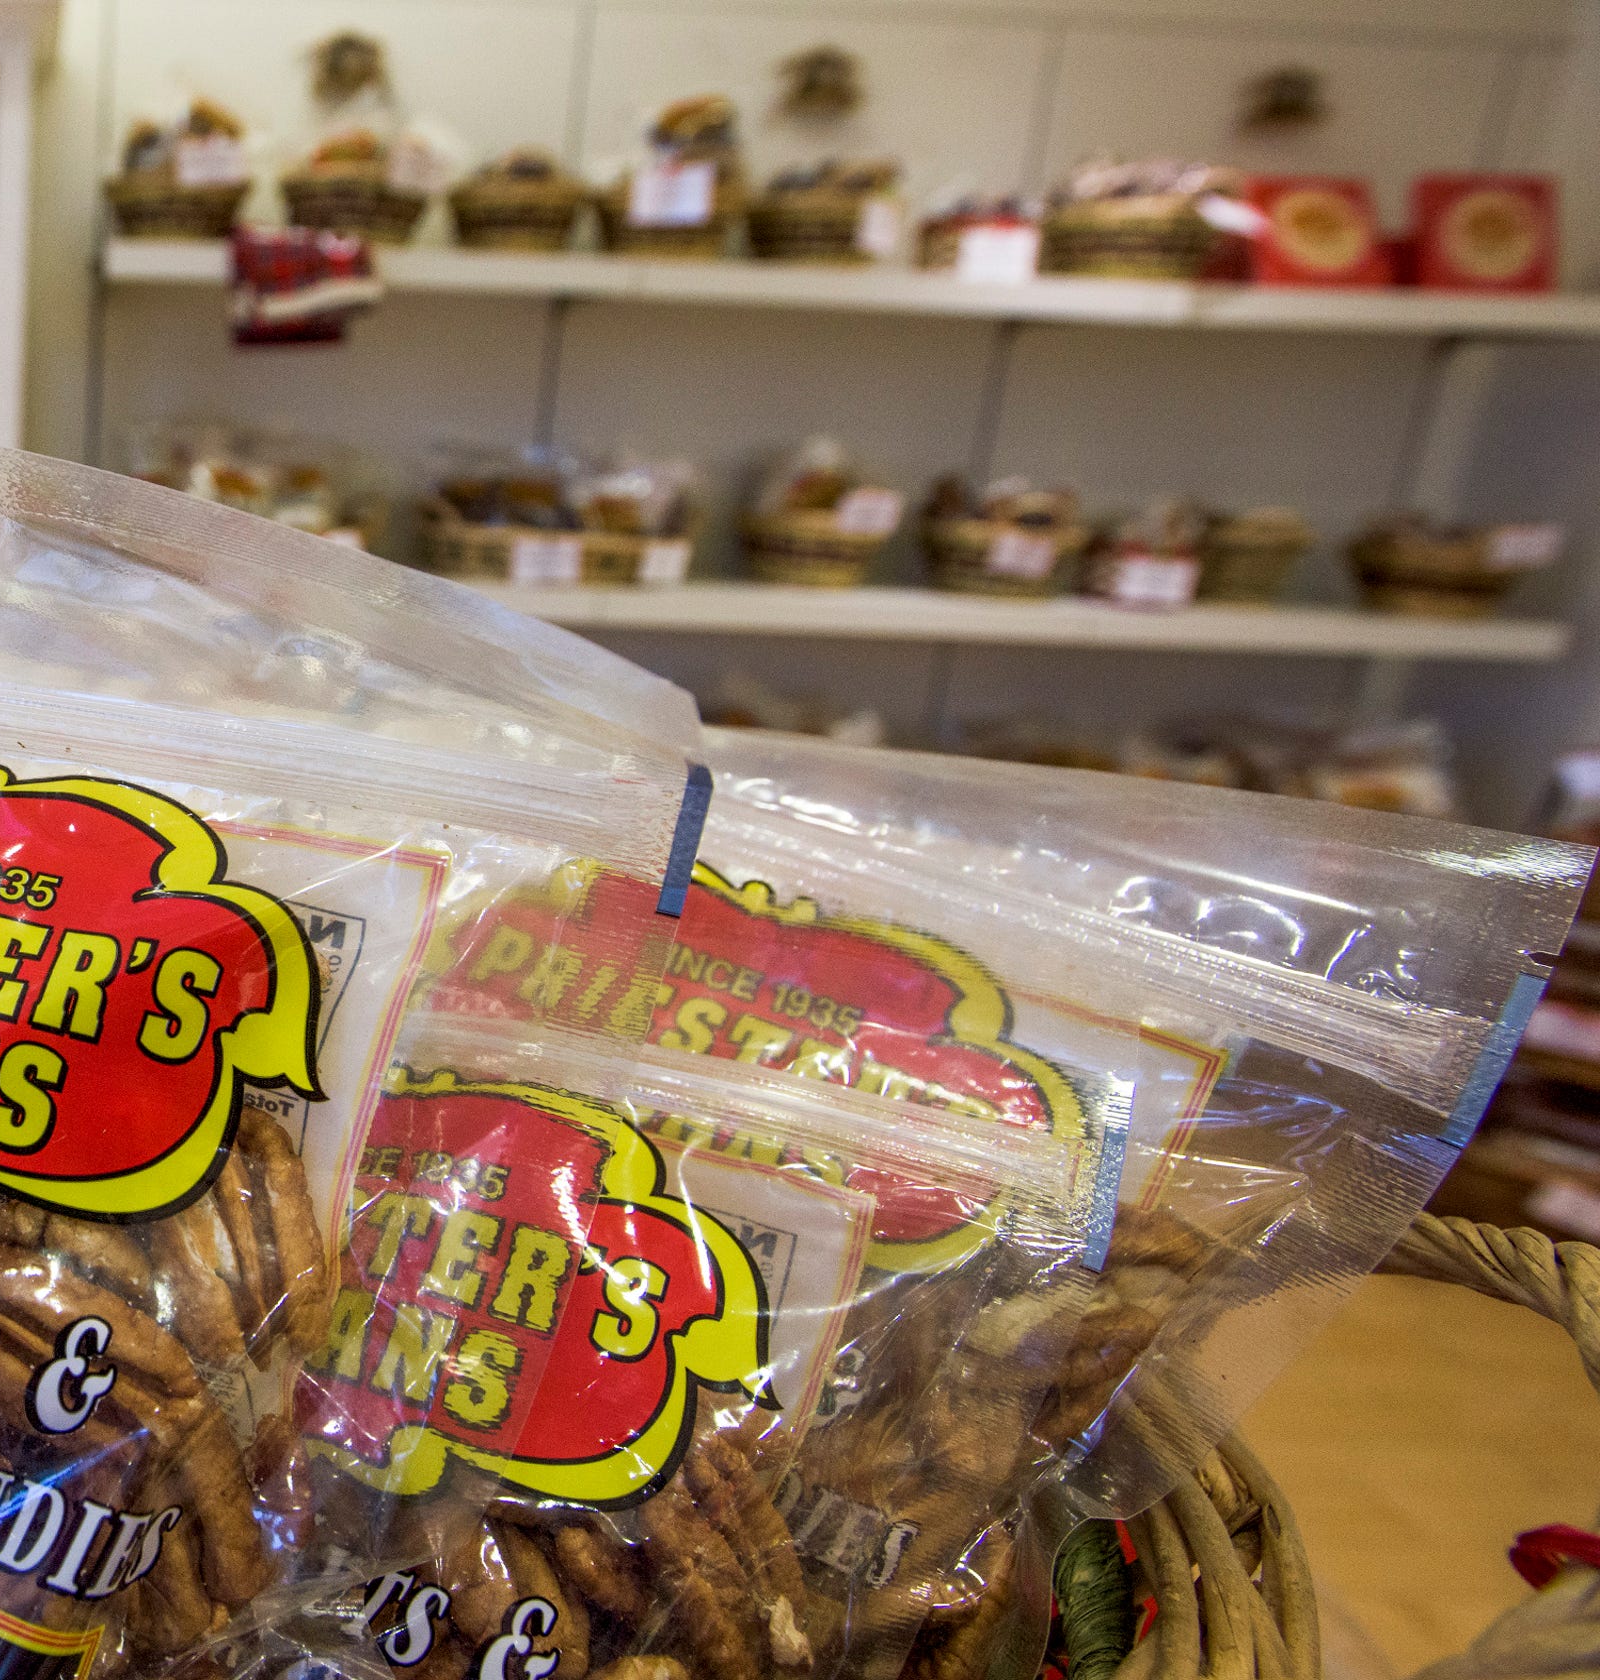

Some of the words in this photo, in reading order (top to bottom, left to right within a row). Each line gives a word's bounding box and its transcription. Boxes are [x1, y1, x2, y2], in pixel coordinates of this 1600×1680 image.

[466, 920, 1002, 1125] PRIEST
[658, 938, 766, 1002] INCE
[768, 981, 864, 1038] 1935
[412, 1151, 512, 1201] 1935
[345, 1186, 668, 1363] TER'S
[22, 1315, 119, 1435] &
[302, 1286, 524, 1430] ANS
[363, 1570, 450, 1668] TS
